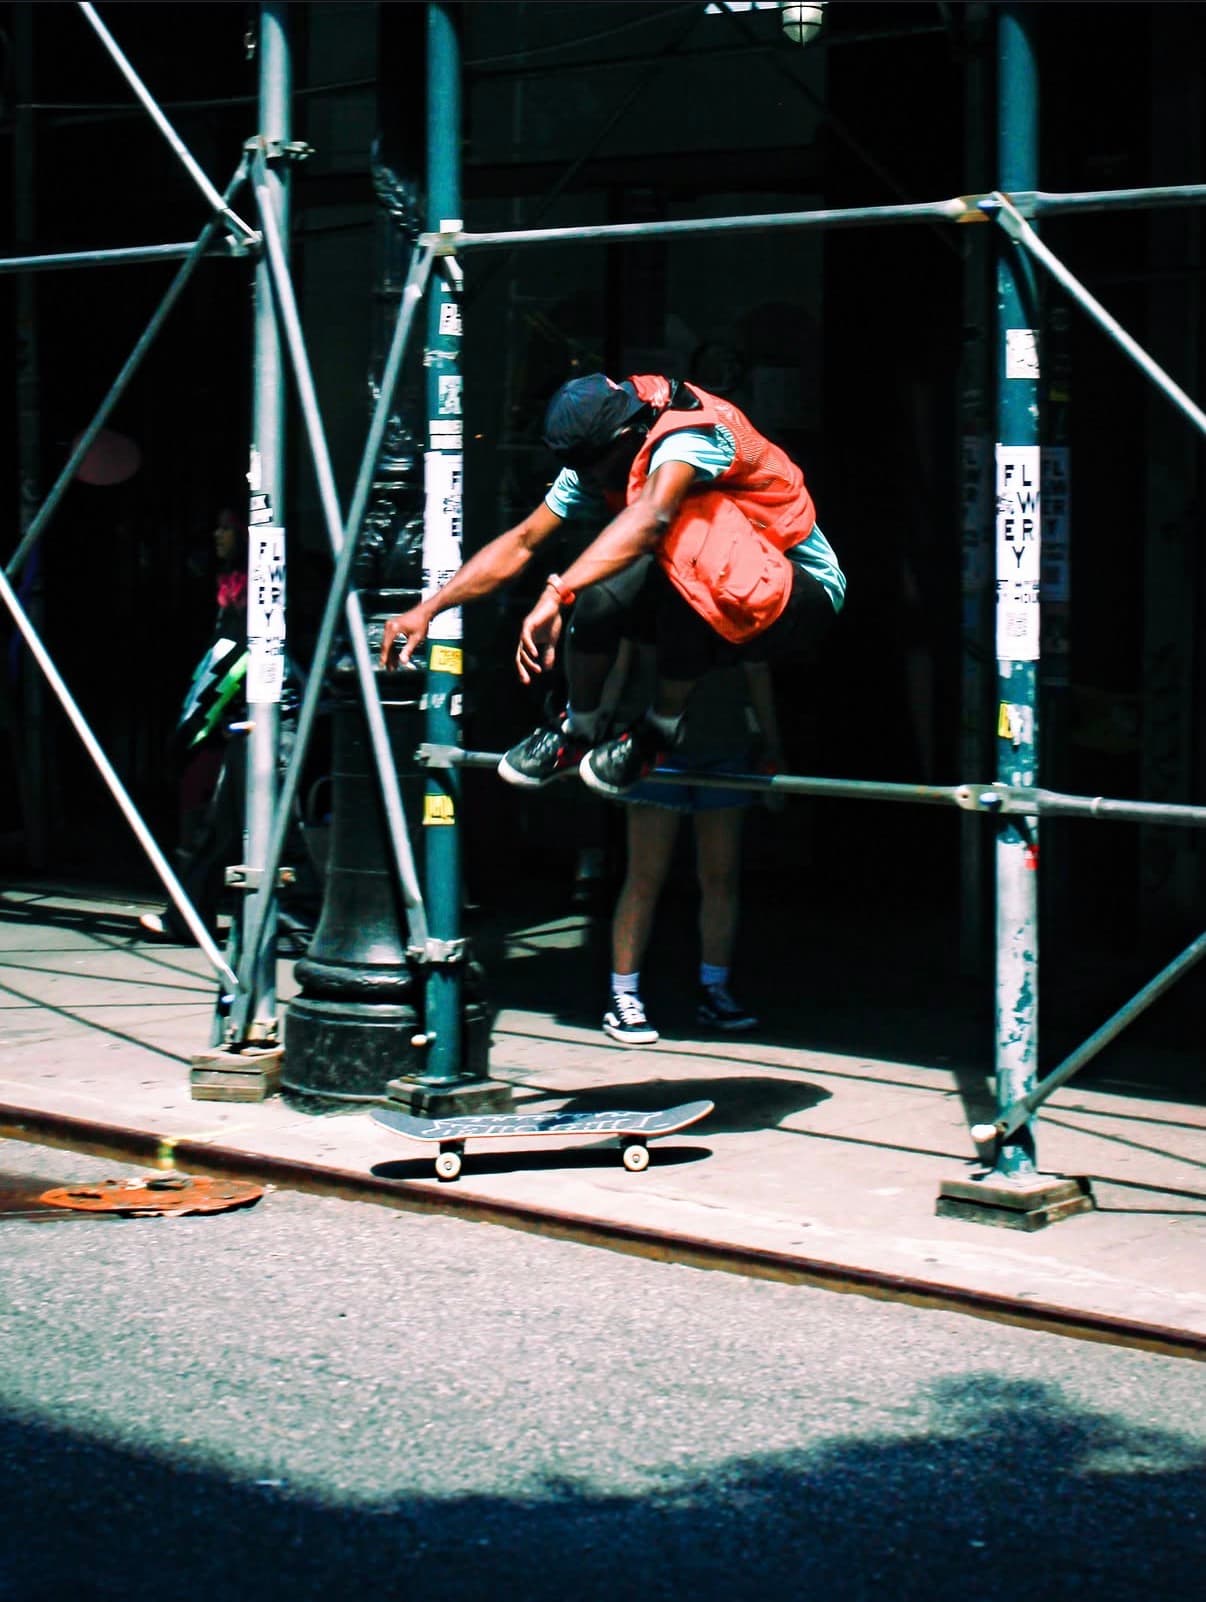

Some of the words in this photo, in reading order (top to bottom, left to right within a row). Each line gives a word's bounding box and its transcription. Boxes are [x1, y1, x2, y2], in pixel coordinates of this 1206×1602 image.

[1004, 464, 1032, 487] FL
[1005, 518, 1033, 541] ER
[1012, 546, 1025, 568] Y
